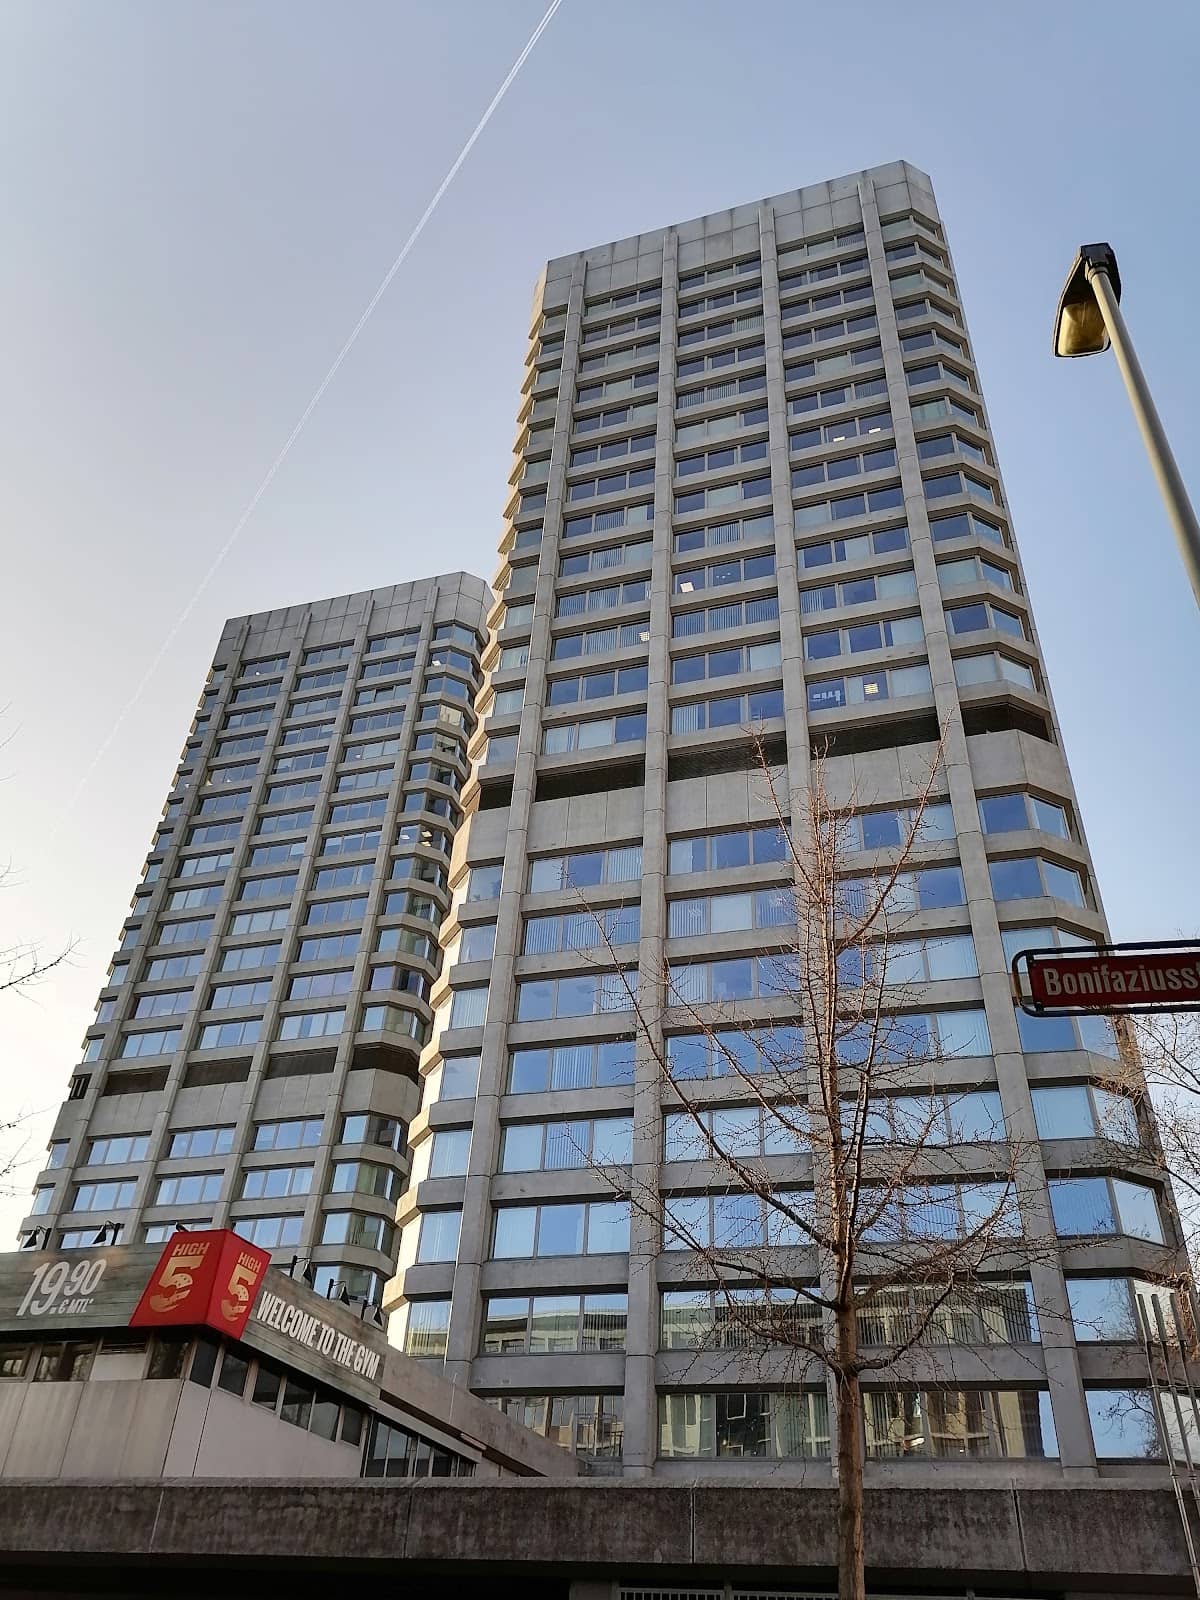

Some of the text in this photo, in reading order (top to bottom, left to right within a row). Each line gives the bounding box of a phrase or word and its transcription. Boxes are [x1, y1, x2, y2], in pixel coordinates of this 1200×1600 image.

[1043, 961, 1200, 996] Bonifaziuss
[172, 1242, 210, 1256] HIGH
[237, 1251, 261, 1273] HIGH
[257, 1291, 380, 1380] WELCOME TO THE GYM
